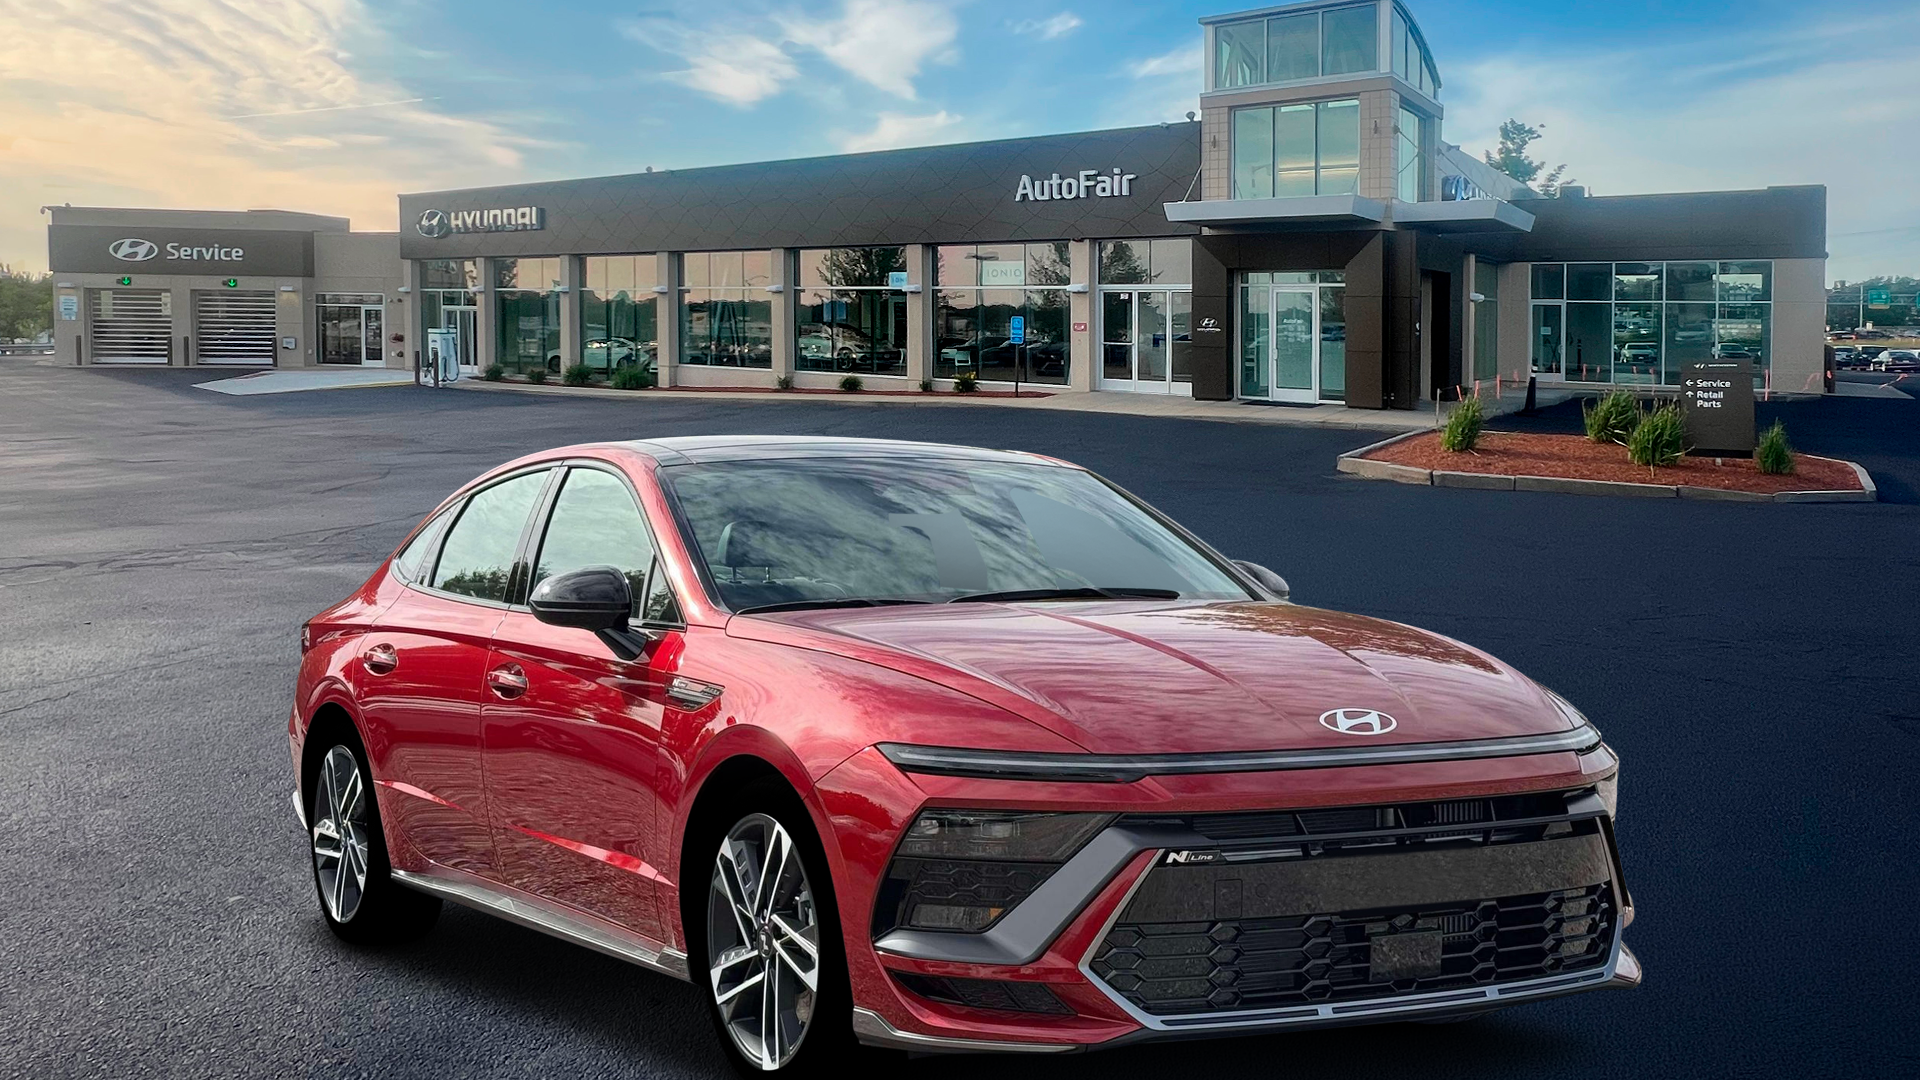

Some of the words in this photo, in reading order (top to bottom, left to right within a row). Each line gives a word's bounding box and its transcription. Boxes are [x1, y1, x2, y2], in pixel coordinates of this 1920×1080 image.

[1015, 167, 1137, 201] AutoFair
[450, 206, 541, 231] HYUNDAI
[166, 242, 244, 260] Service
[1696, 379, 1731, 388] Service
[1696, 390, 1724, 399] Retail
[1696, 400, 1722, 408] Parts
